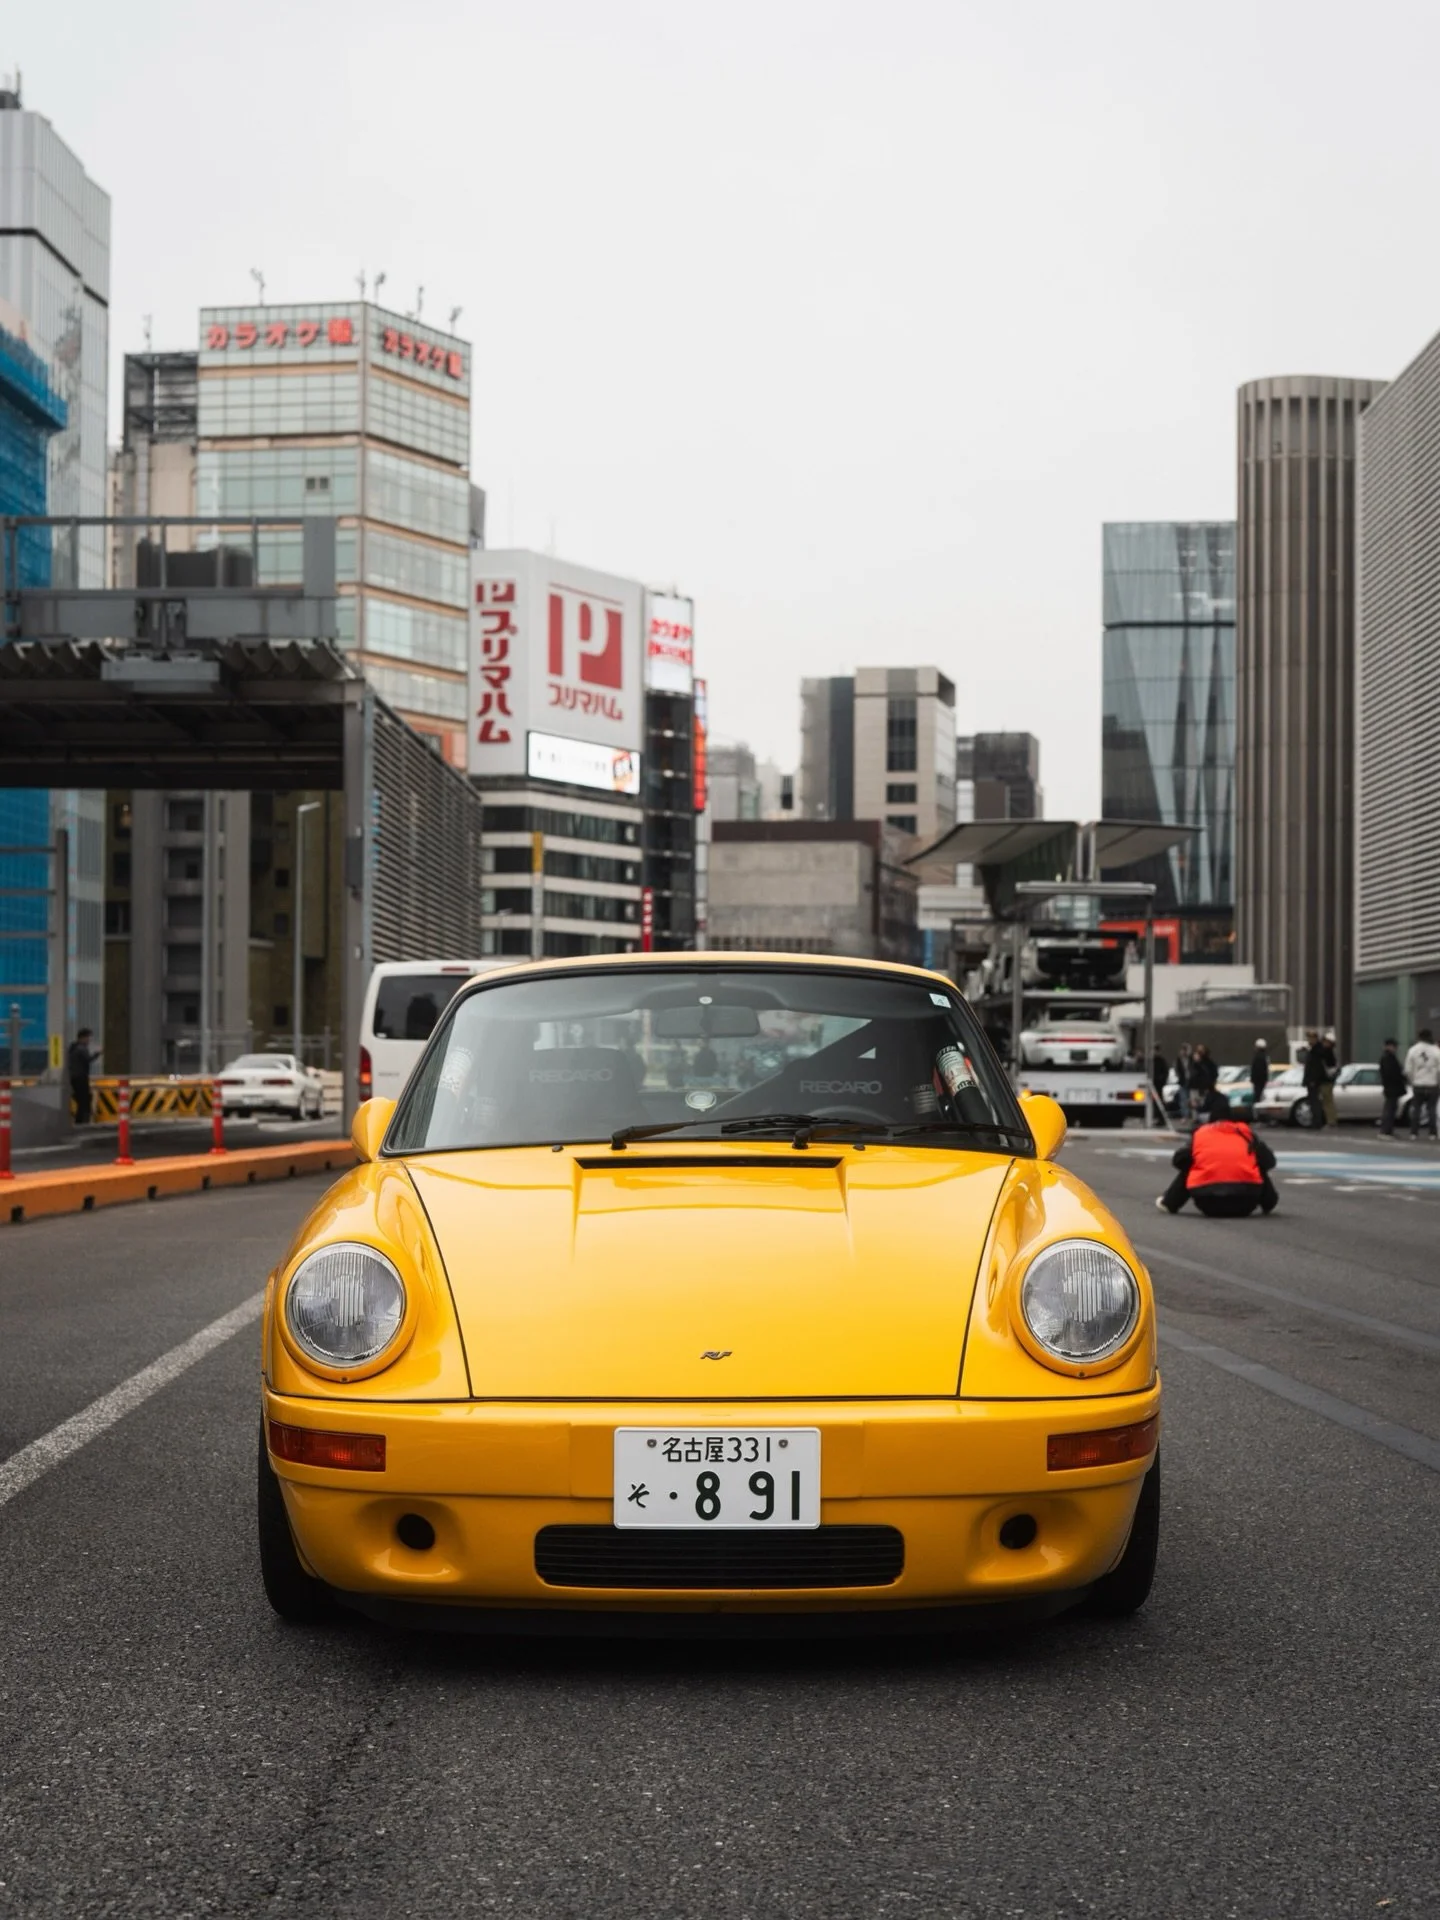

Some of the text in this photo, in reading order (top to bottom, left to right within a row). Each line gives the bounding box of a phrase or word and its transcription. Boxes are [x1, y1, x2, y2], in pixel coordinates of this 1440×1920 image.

[476, 610, 518, 744] プリマハム
[547, 682, 624, 722] プリマハム
[528, 1068, 613, 1084] RECARO
[799, 1080, 883, 1094] RECARO
